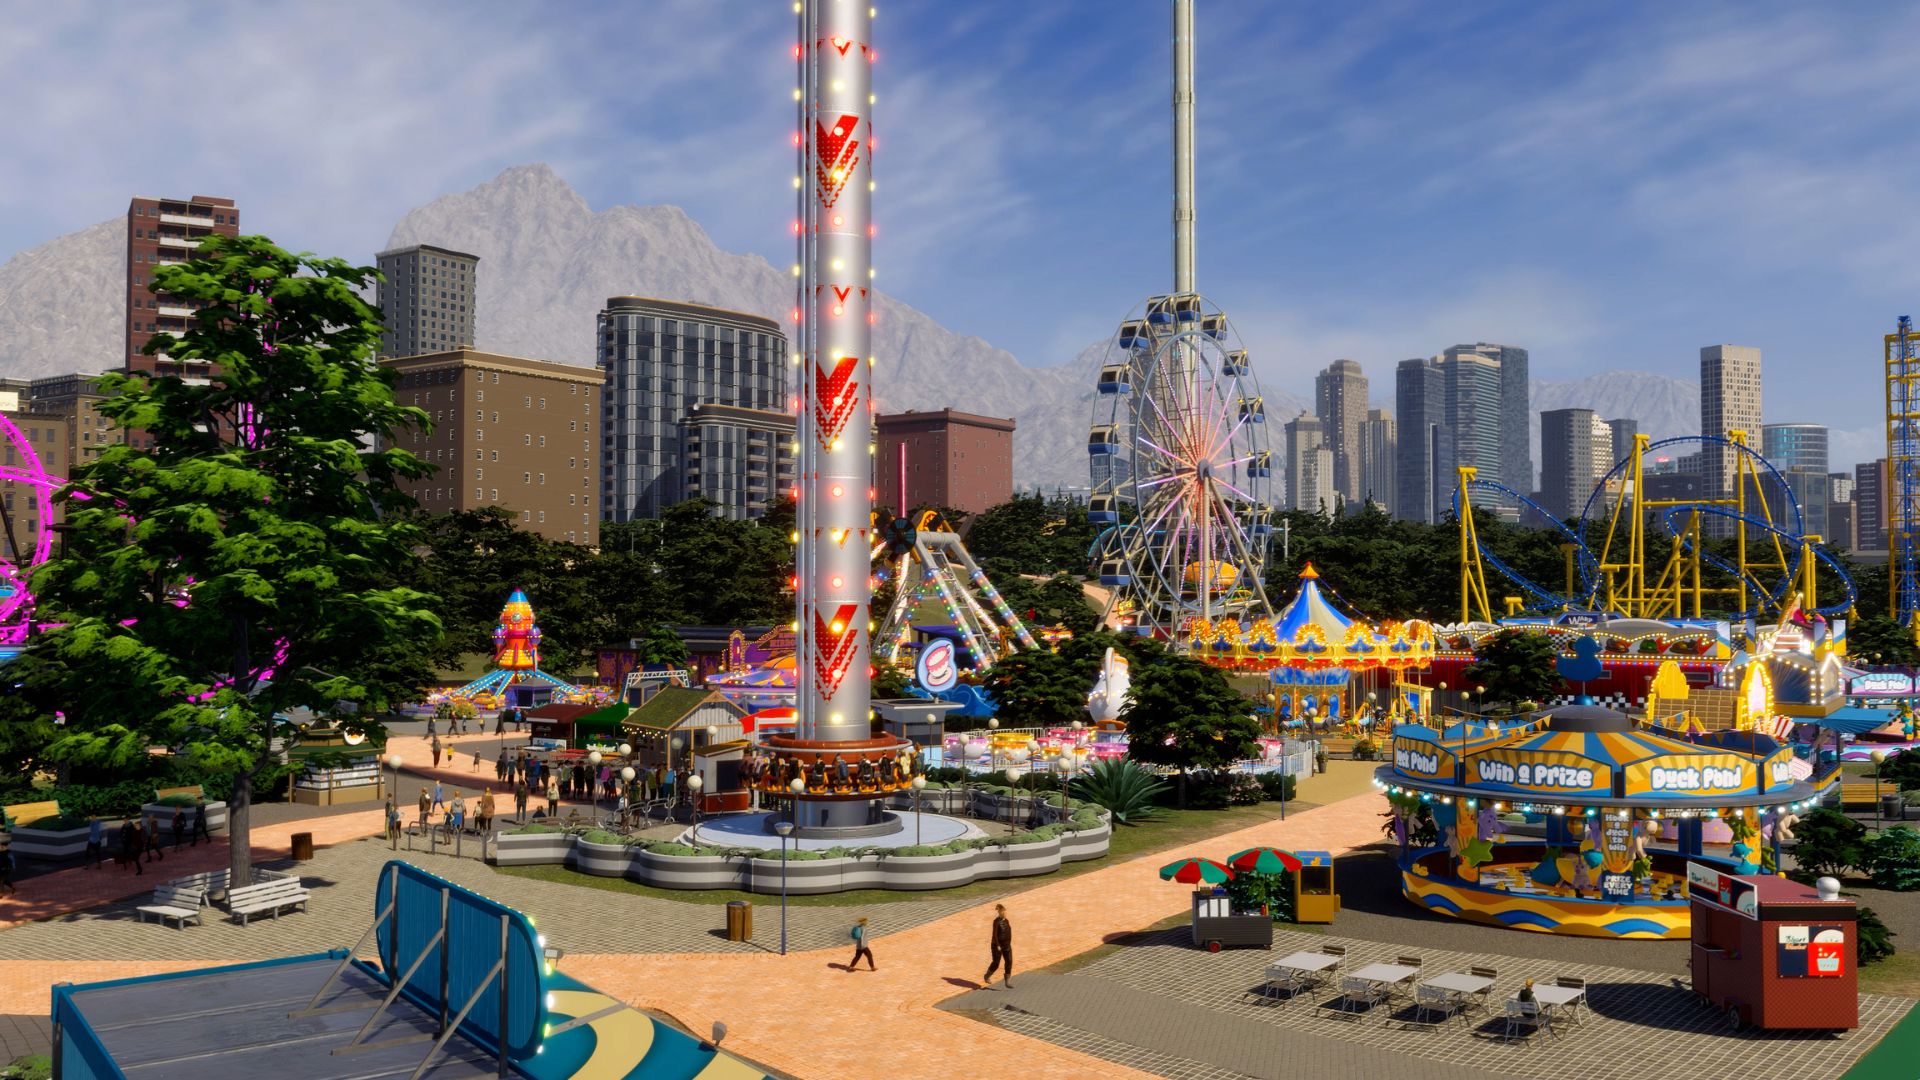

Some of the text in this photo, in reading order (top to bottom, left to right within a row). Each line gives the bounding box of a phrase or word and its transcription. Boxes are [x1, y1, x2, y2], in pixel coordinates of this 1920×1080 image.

[1410, 750, 1438, 774] Pond
[1478, 760, 1594, 787] Win a Prize
[1651, 765, 1742, 790] Duck Pond
[1612, 836, 1624, 844] to
[1603, 882, 1633, 890] EVERY
[1605, 874, 1632, 883] PRIZE
